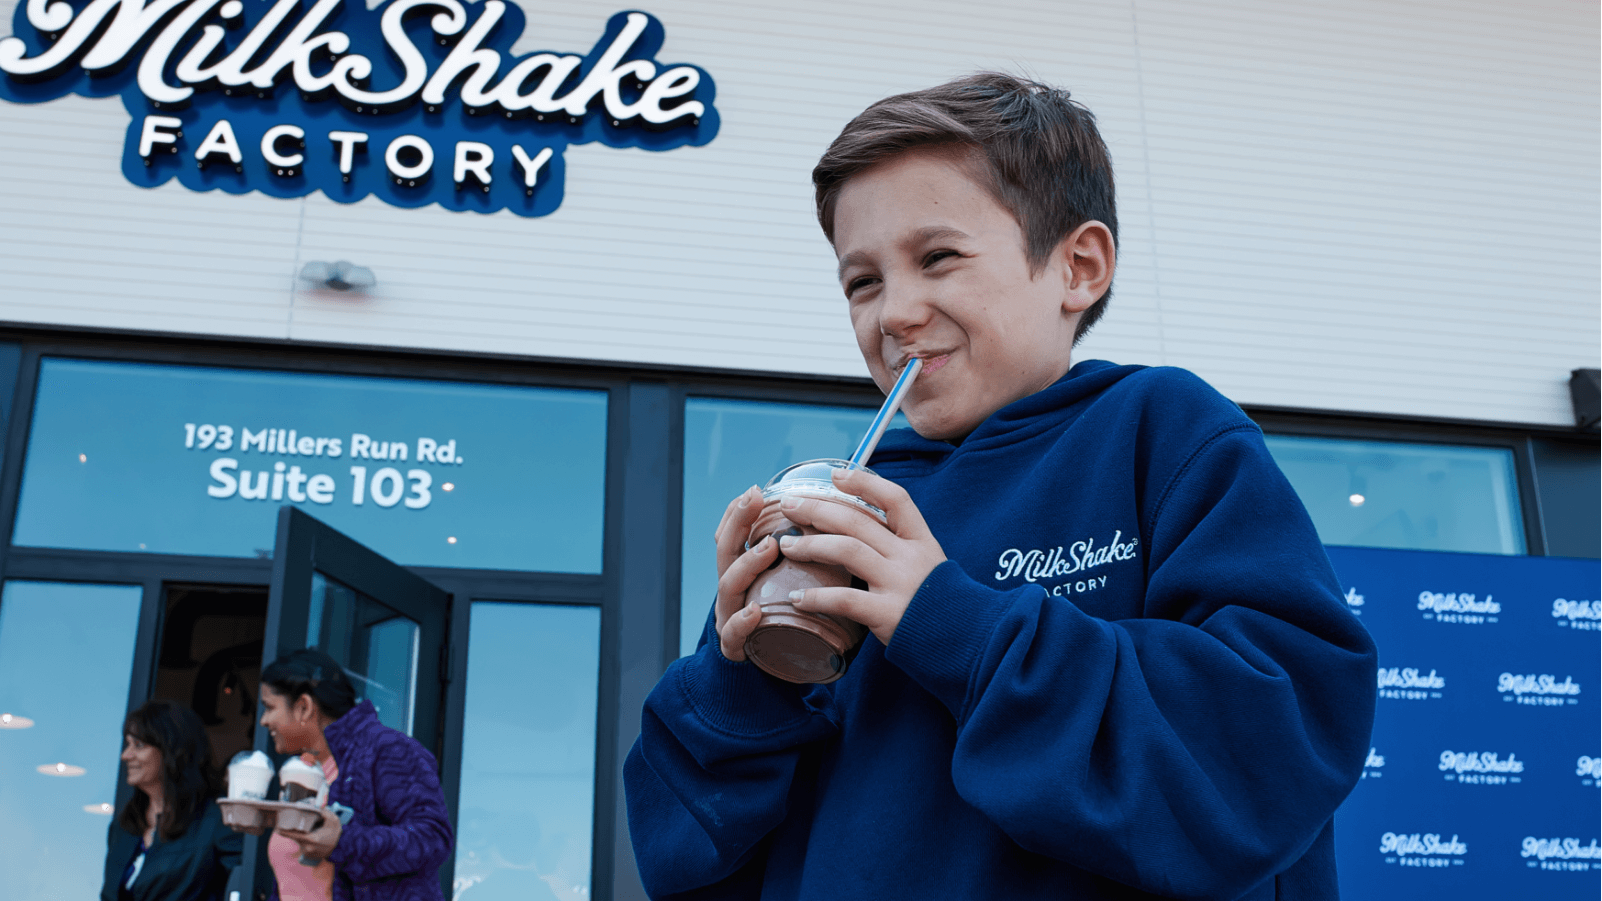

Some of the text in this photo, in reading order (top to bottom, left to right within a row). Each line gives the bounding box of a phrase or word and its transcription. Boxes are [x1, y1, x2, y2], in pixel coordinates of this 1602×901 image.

[138, 115, 554, 188] FACTORY
[184, 423, 463, 464] 193 Millers Run Rd.
[207, 457, 432, 509] Suite 103
[1044, 575, 1107, 598] CTORY
